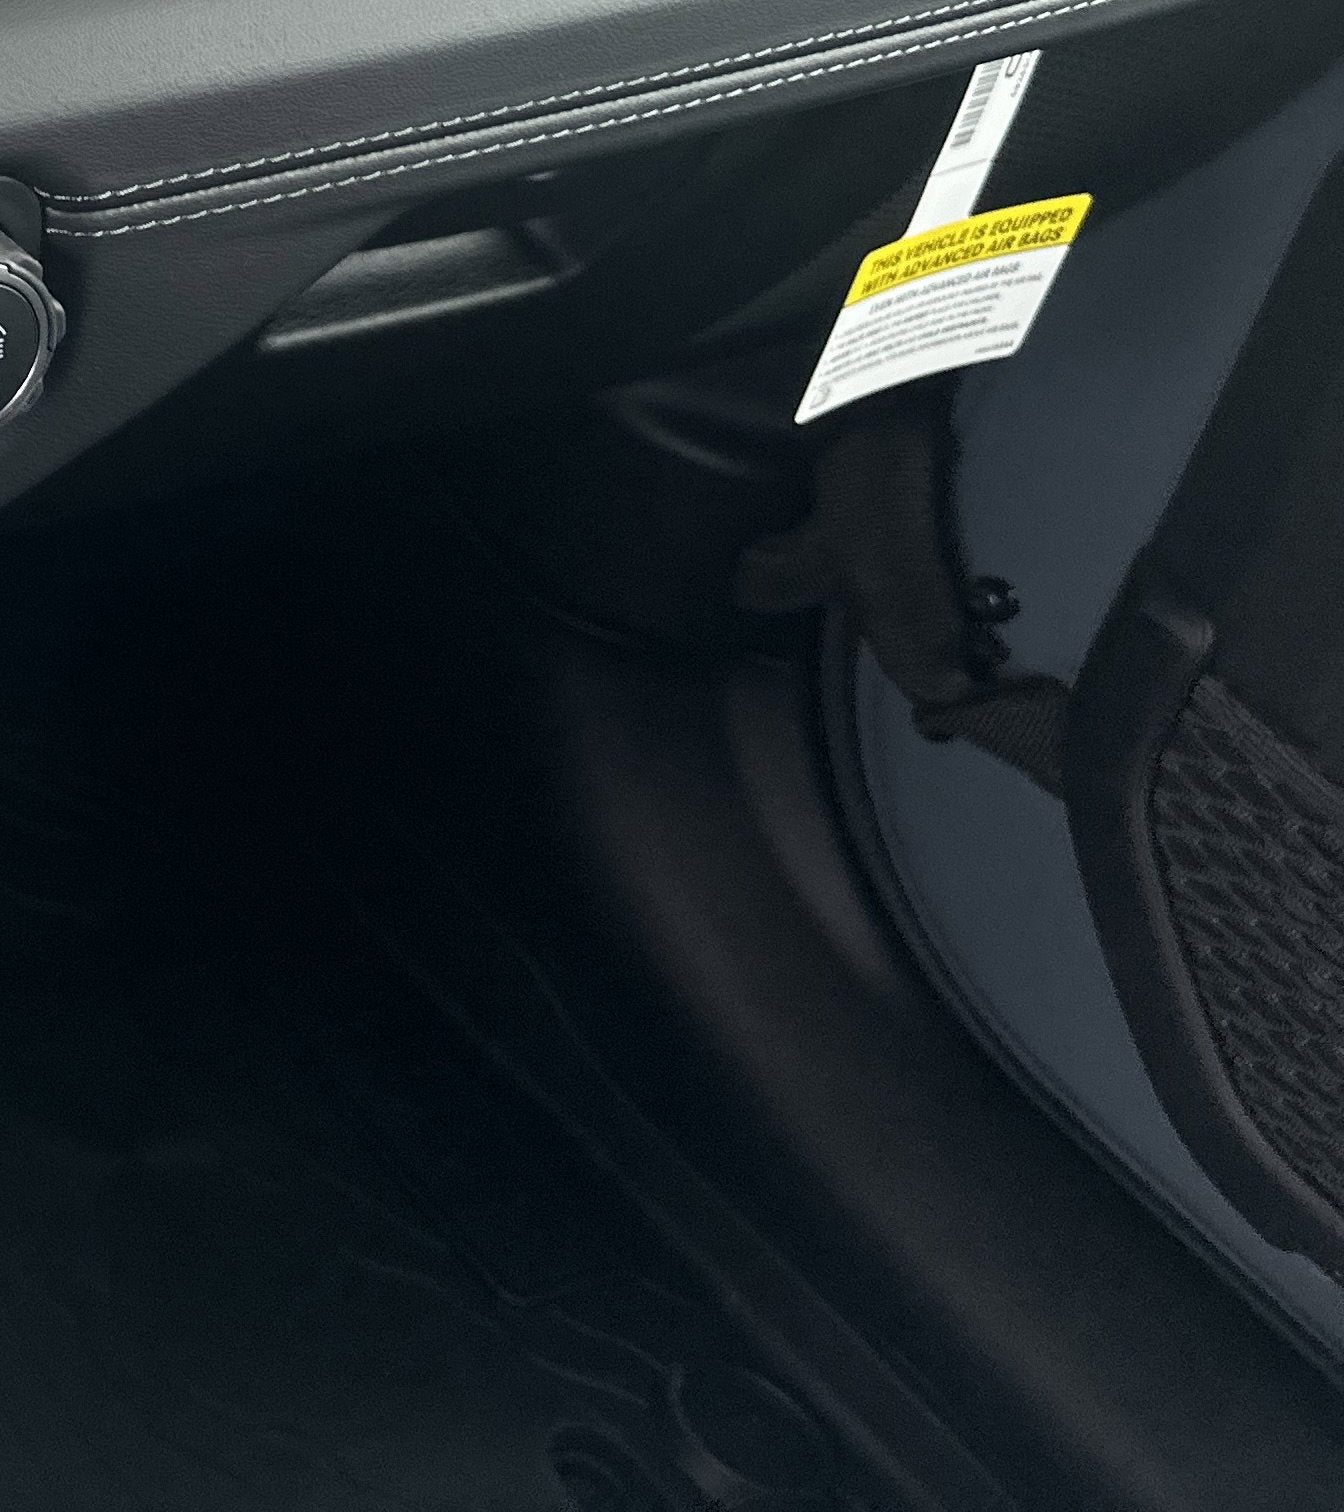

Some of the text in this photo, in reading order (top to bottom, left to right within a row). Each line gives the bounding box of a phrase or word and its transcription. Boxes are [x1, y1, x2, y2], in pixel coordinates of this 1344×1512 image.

[871, 250, 904, 275] THIS
[905, 232, 970, 261] VEHICLE
[989, 206, 1074, 236] EQUIPPED
[899, 243, 985, 280] ADVANCED
[986, 234, 1017, 255] AIR
